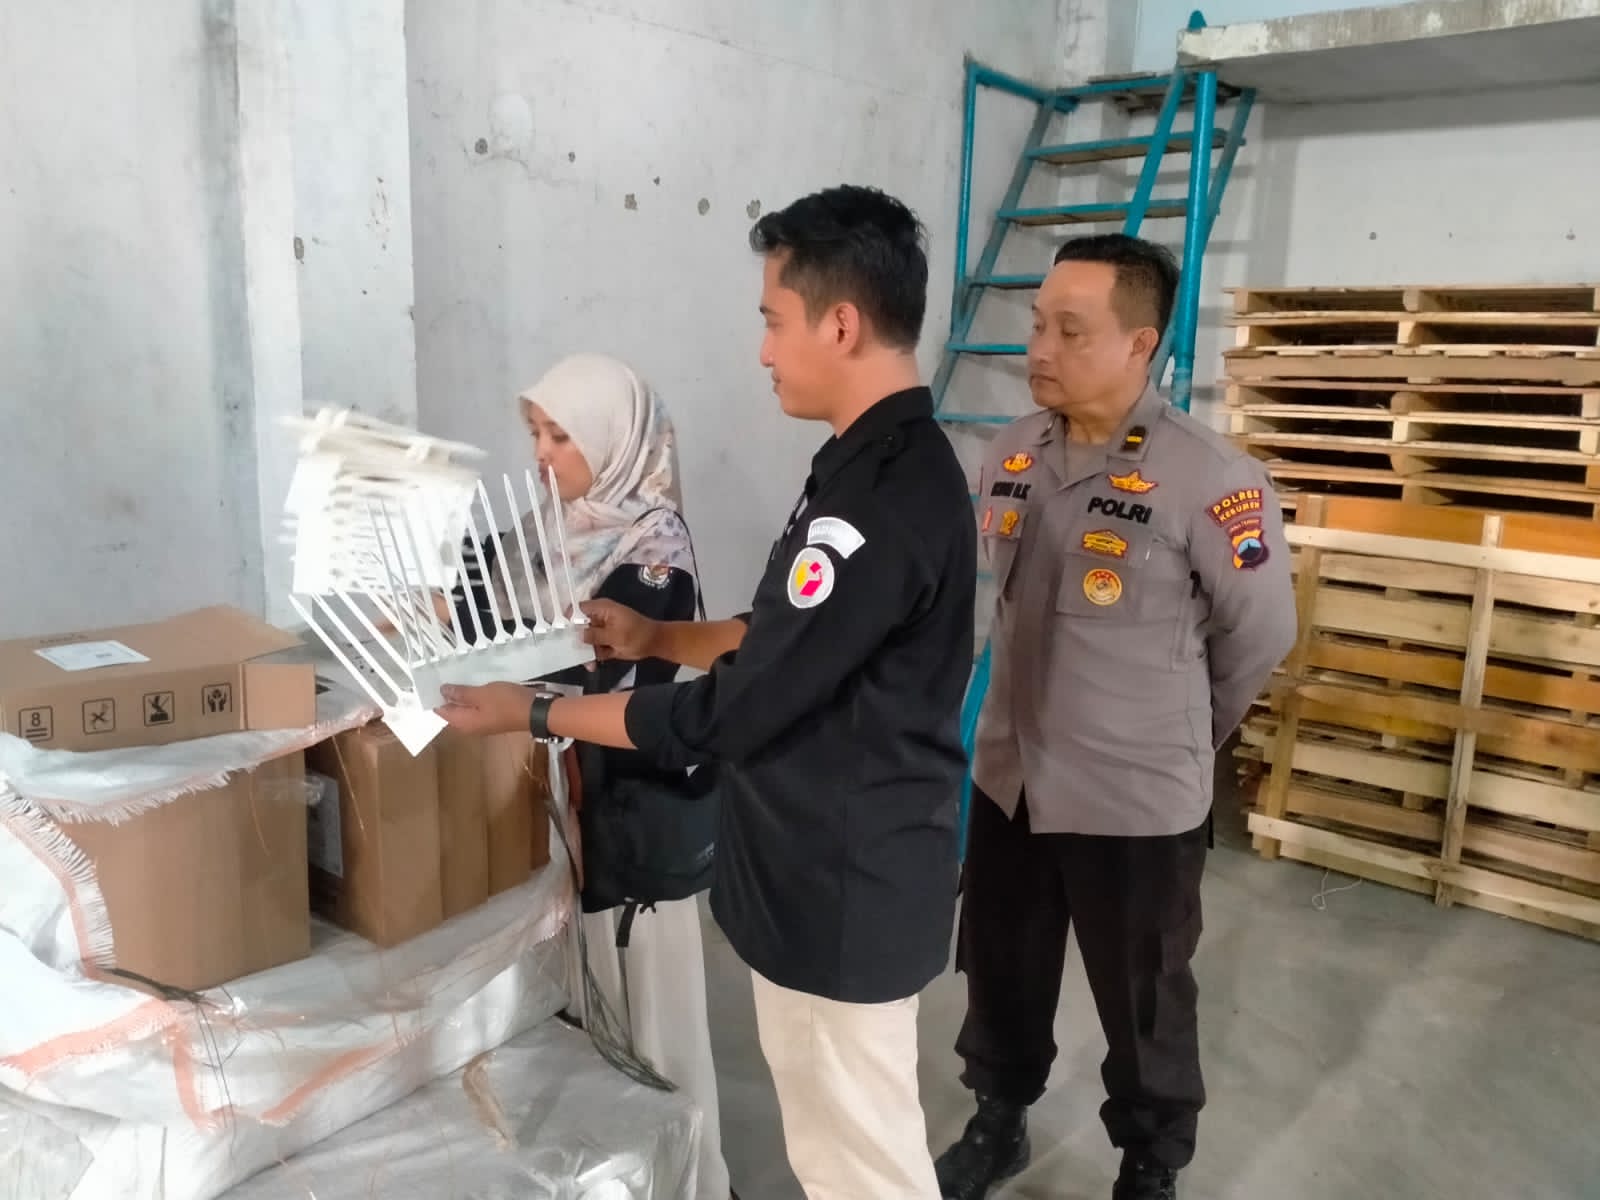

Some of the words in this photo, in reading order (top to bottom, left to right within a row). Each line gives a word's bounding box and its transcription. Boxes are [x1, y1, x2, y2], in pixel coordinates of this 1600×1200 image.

[1088, 496, 1153, 525] POLRI
[1213, 489, 1260, 515] POLRES
[31, 711, 41, 728] 8
